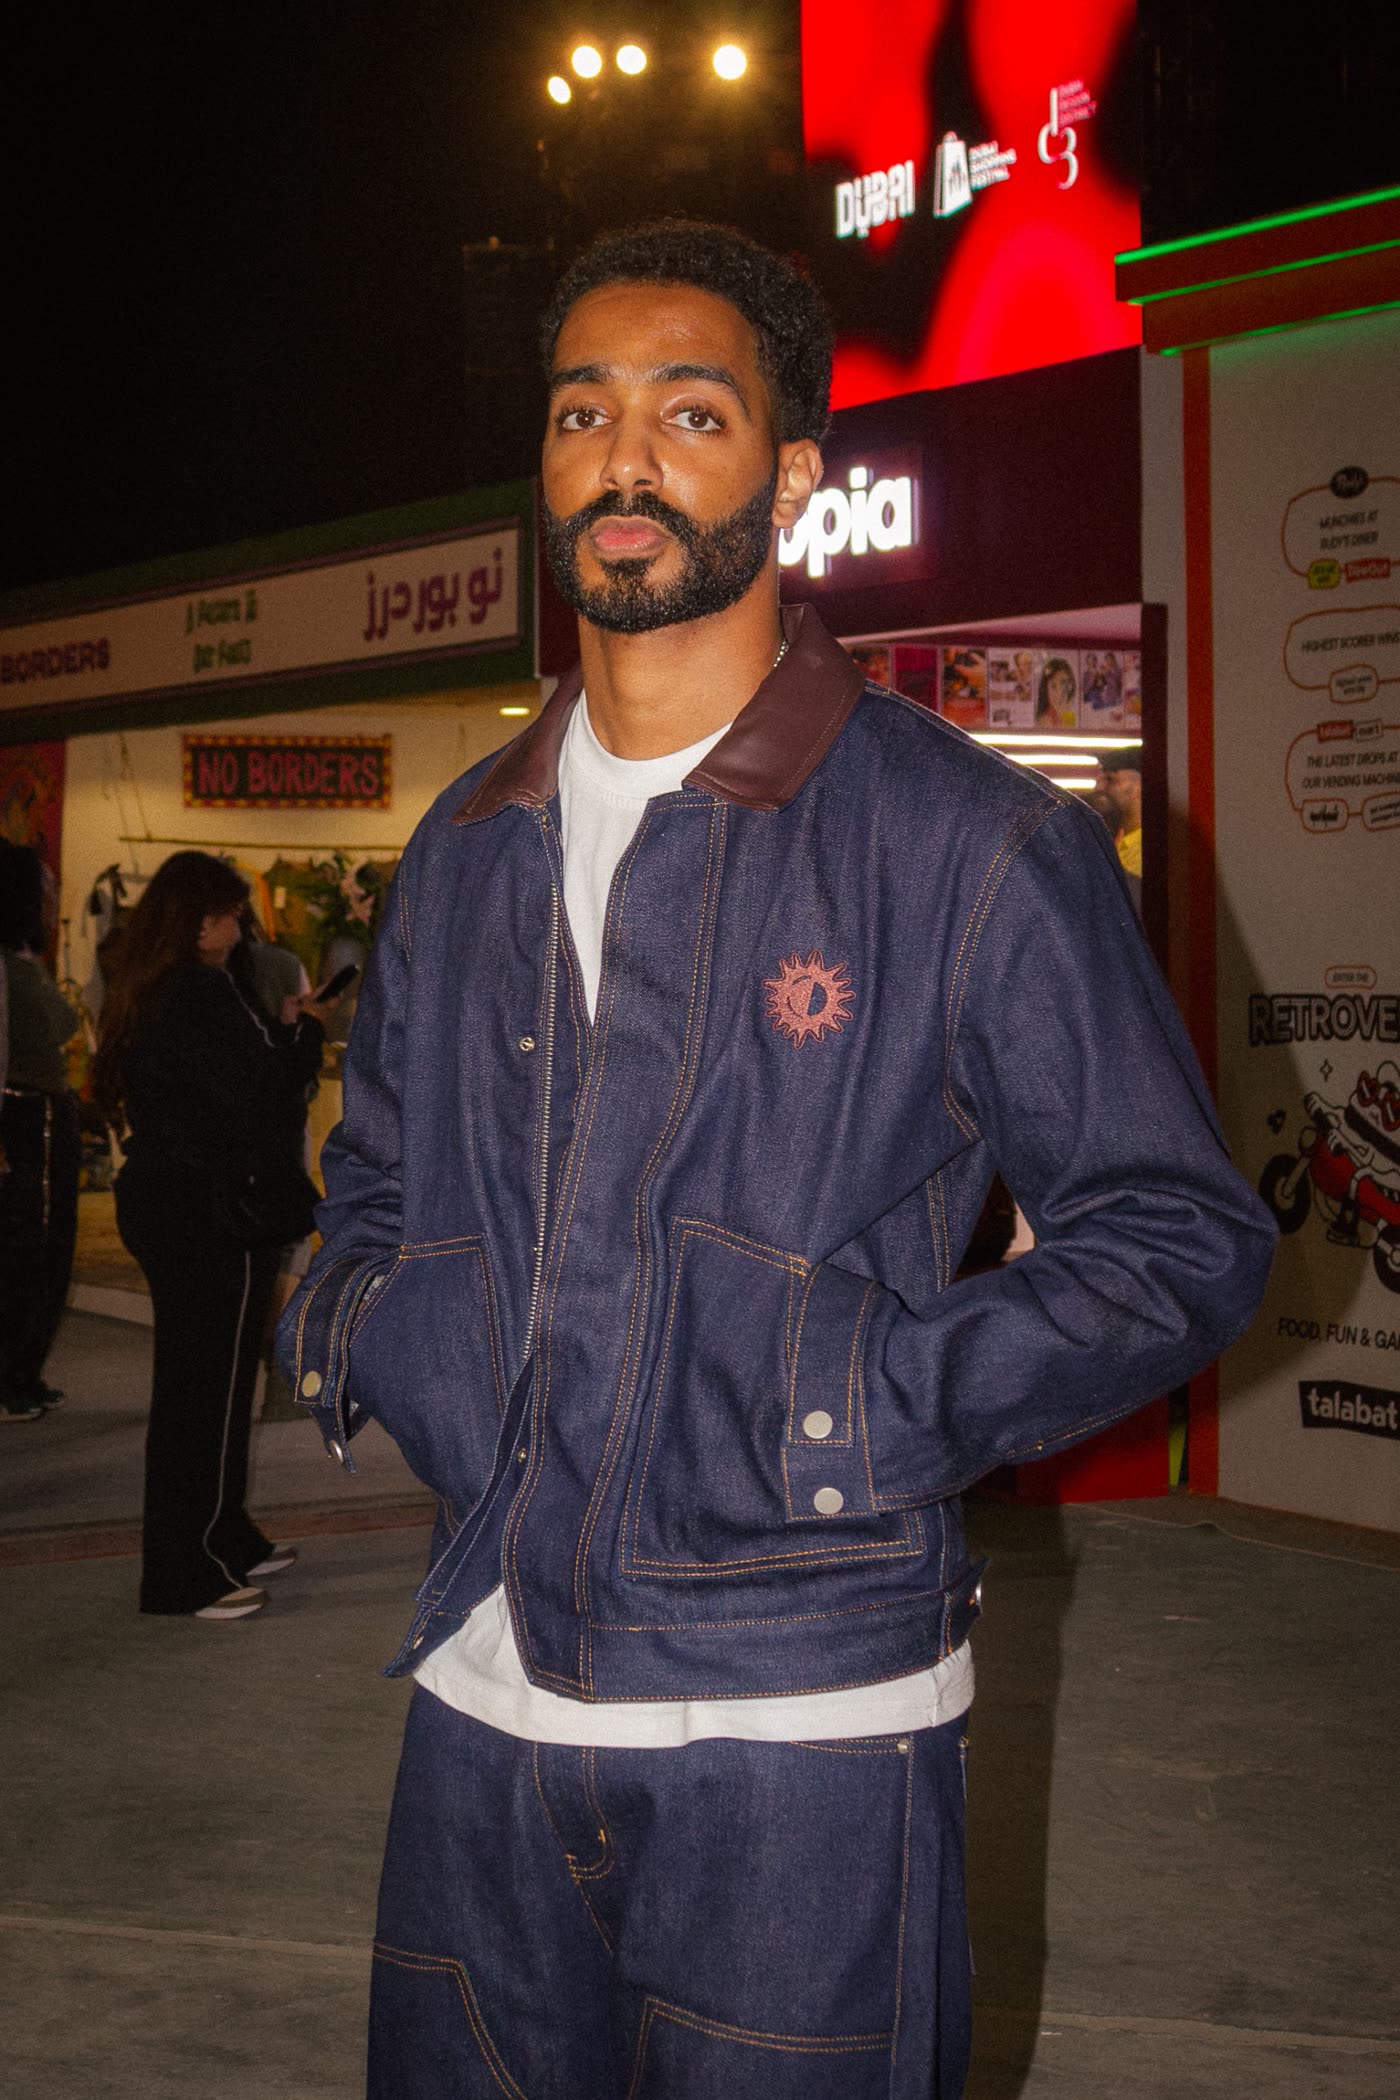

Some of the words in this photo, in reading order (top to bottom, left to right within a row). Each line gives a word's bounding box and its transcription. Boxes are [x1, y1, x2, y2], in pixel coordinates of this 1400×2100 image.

[198, 753, 238, 794] NO
[249, 752, 379, 796] BORDERS
[1249, 994, 1400, 1046] RETROVE
[1326, 1323, 1358, 1345] FUN
[1360, 1328, 1371, 1348] &
[1375, 1330, 1400, 1351] GA
[1307, 1387, 1398, 1430] talabat
